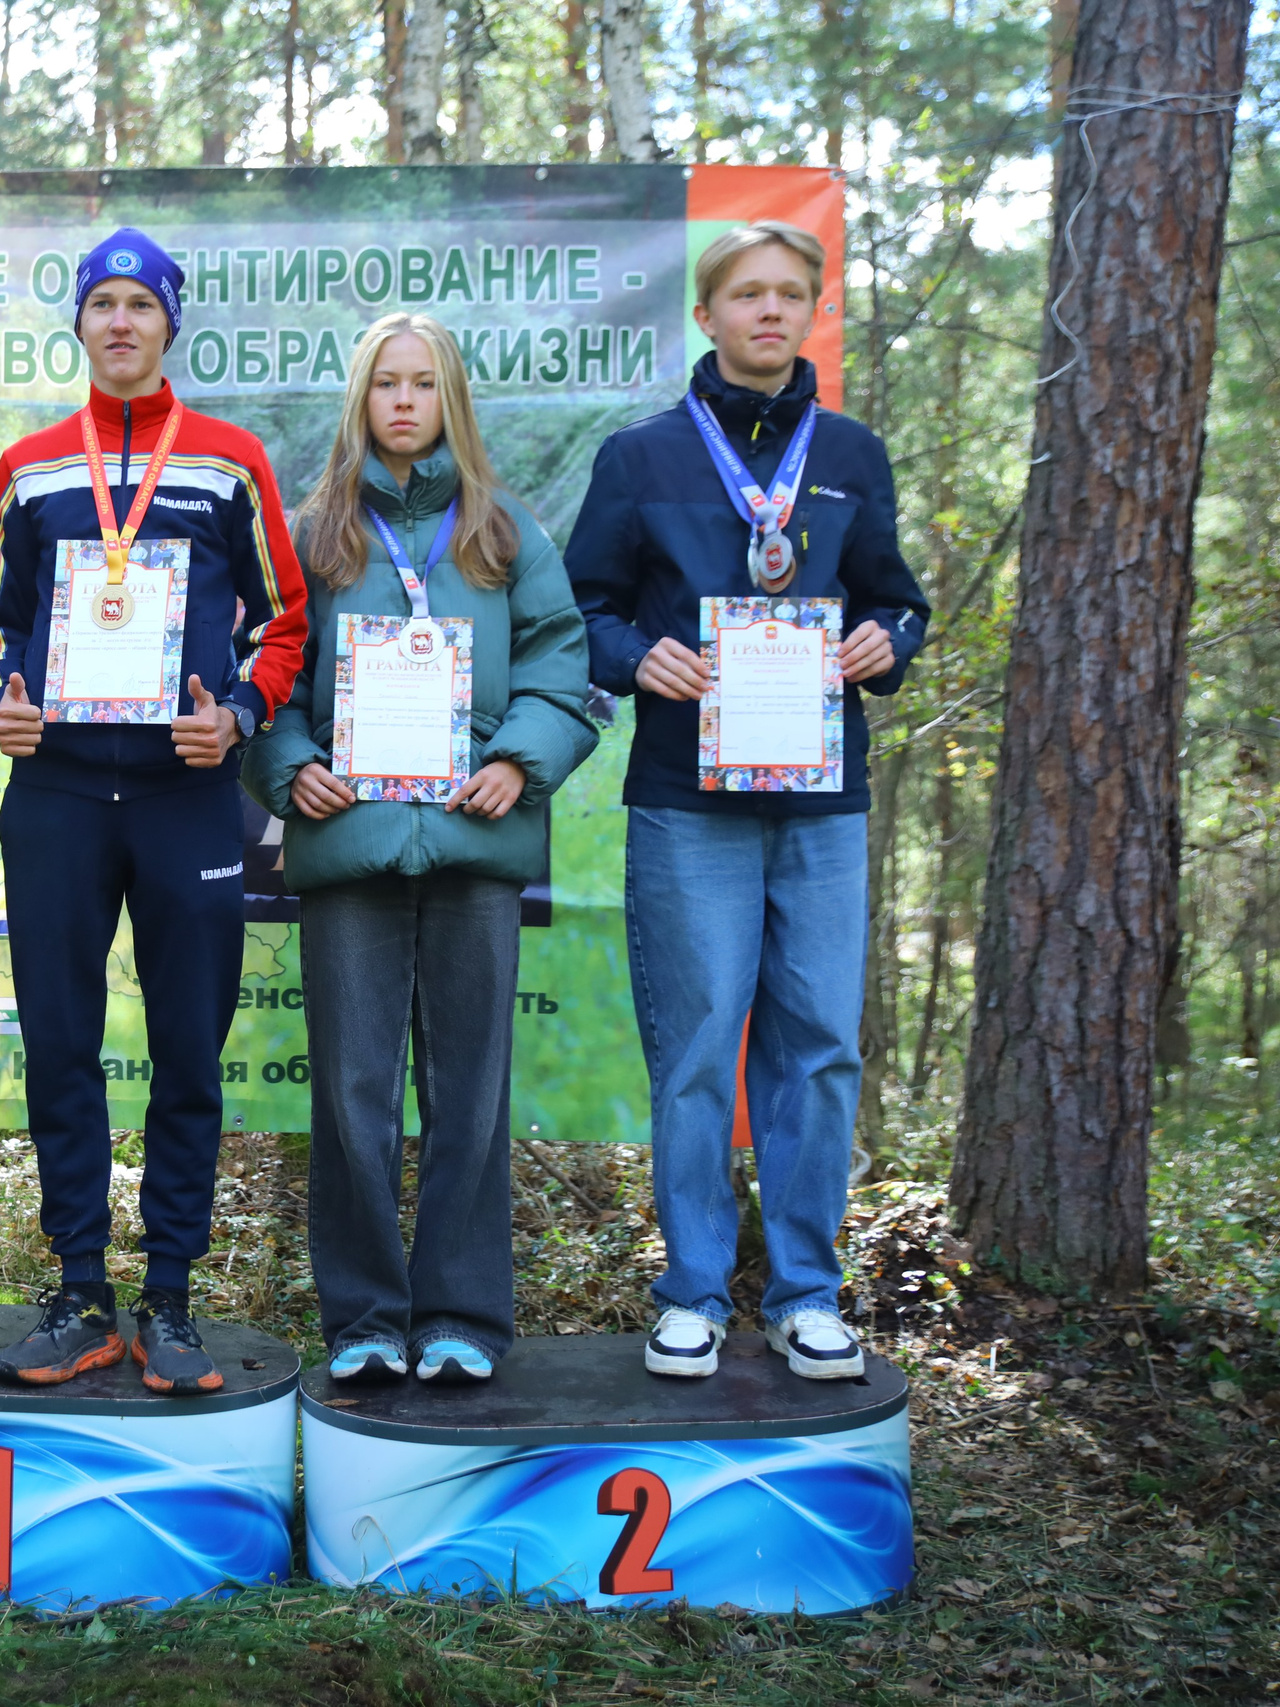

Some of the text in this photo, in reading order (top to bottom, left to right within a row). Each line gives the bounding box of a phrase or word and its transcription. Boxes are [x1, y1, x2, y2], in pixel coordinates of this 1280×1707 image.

[32, 246, 600, 306] ОНТИРОВАНИЕ
[188, 327, 370, 385] ОБРА
[84, 416, 109, 514] ЧЕЛЯБИНСКАЯ ОБЛАСТЬ
[135, 472, 156, 512] ОБЛАСТЬ
[153, 495, 213, 514] КОМАНДА74
[82, 582, 157, 595] ГРОТА
[731, 642, 811, 655] ГРАМОТА
[598, 1467, 673, 1596] 2
